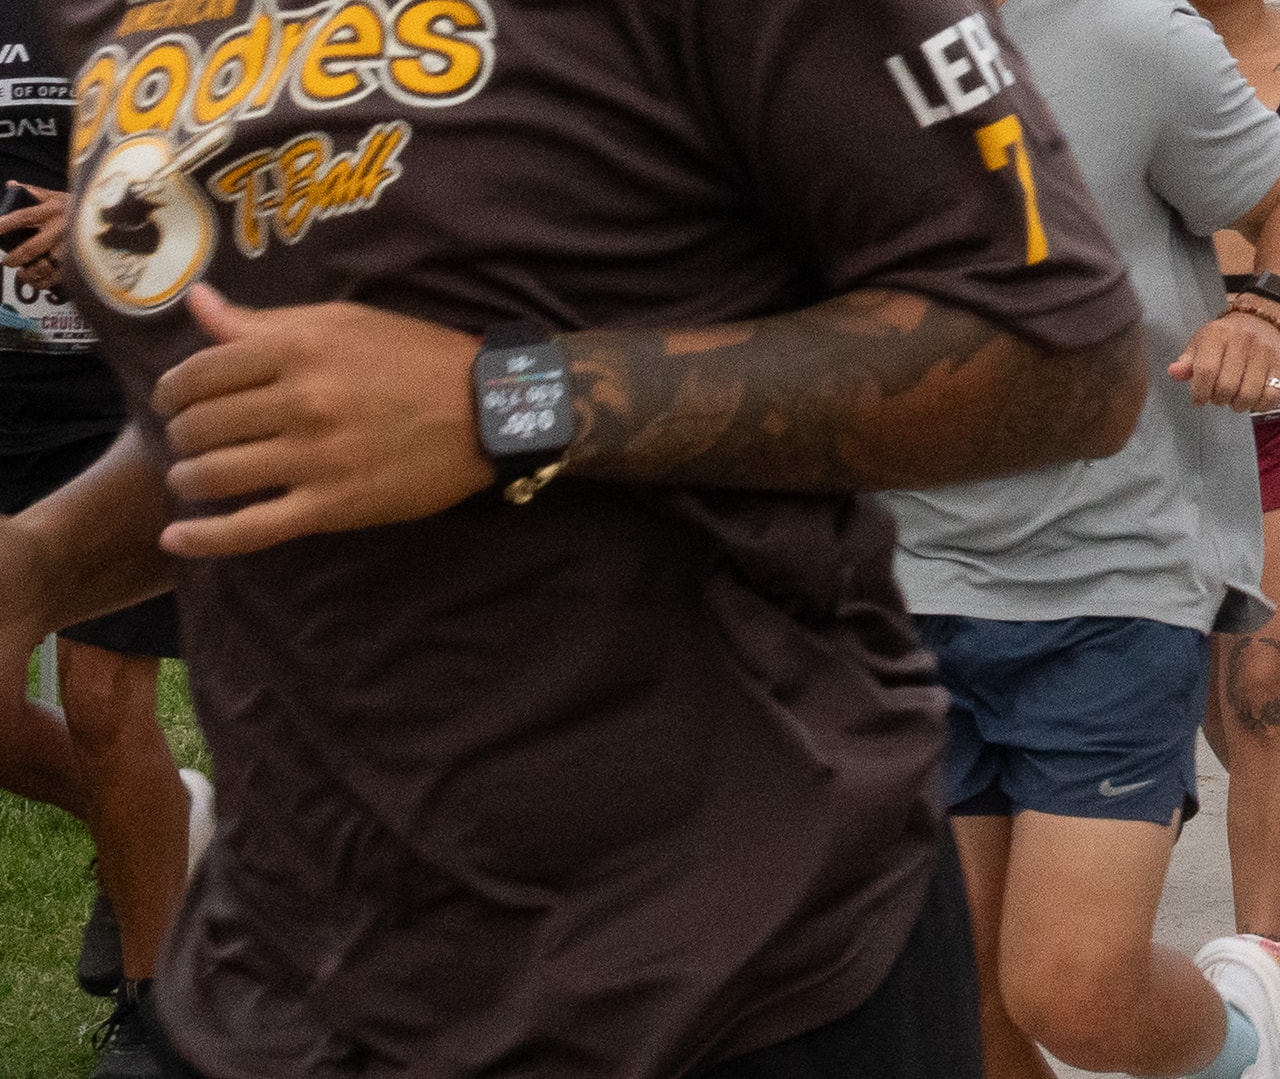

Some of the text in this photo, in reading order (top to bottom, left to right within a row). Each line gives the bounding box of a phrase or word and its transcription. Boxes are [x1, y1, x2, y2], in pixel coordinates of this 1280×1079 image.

[13, 86, 34, 98] OF
[208, 120, 412, 258] T-Ball
[976, 113, 1049, 267] 7
